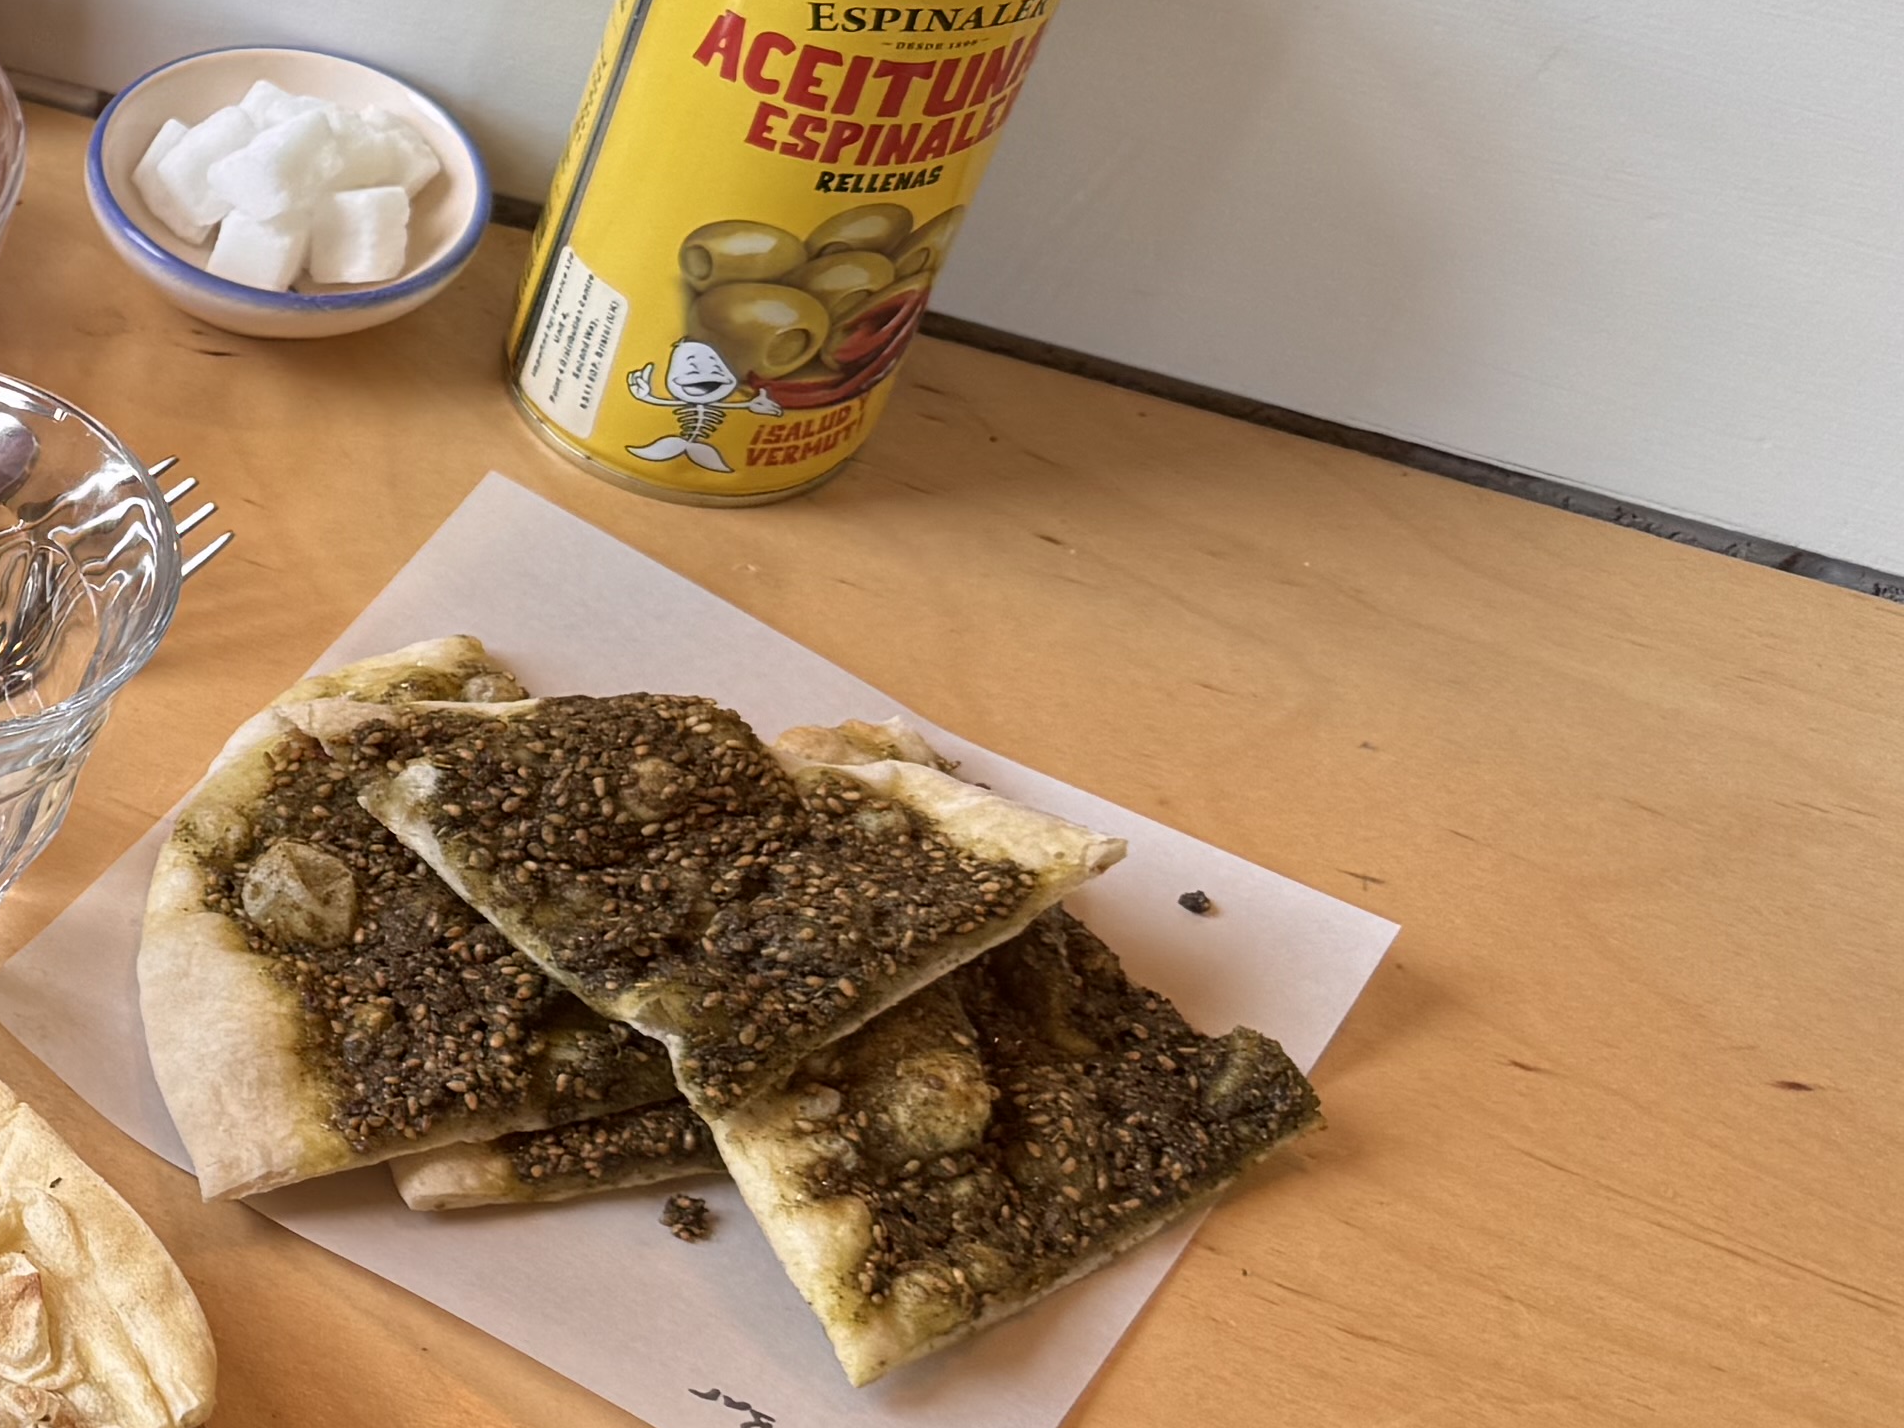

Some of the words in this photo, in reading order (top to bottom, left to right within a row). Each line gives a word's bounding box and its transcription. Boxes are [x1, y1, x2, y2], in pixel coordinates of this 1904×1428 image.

[895, 40, 945, 51] DESDE
[692, 8, 1049, 119] ACEITUNA
[814, 164, 945, 194] RELLENAS
